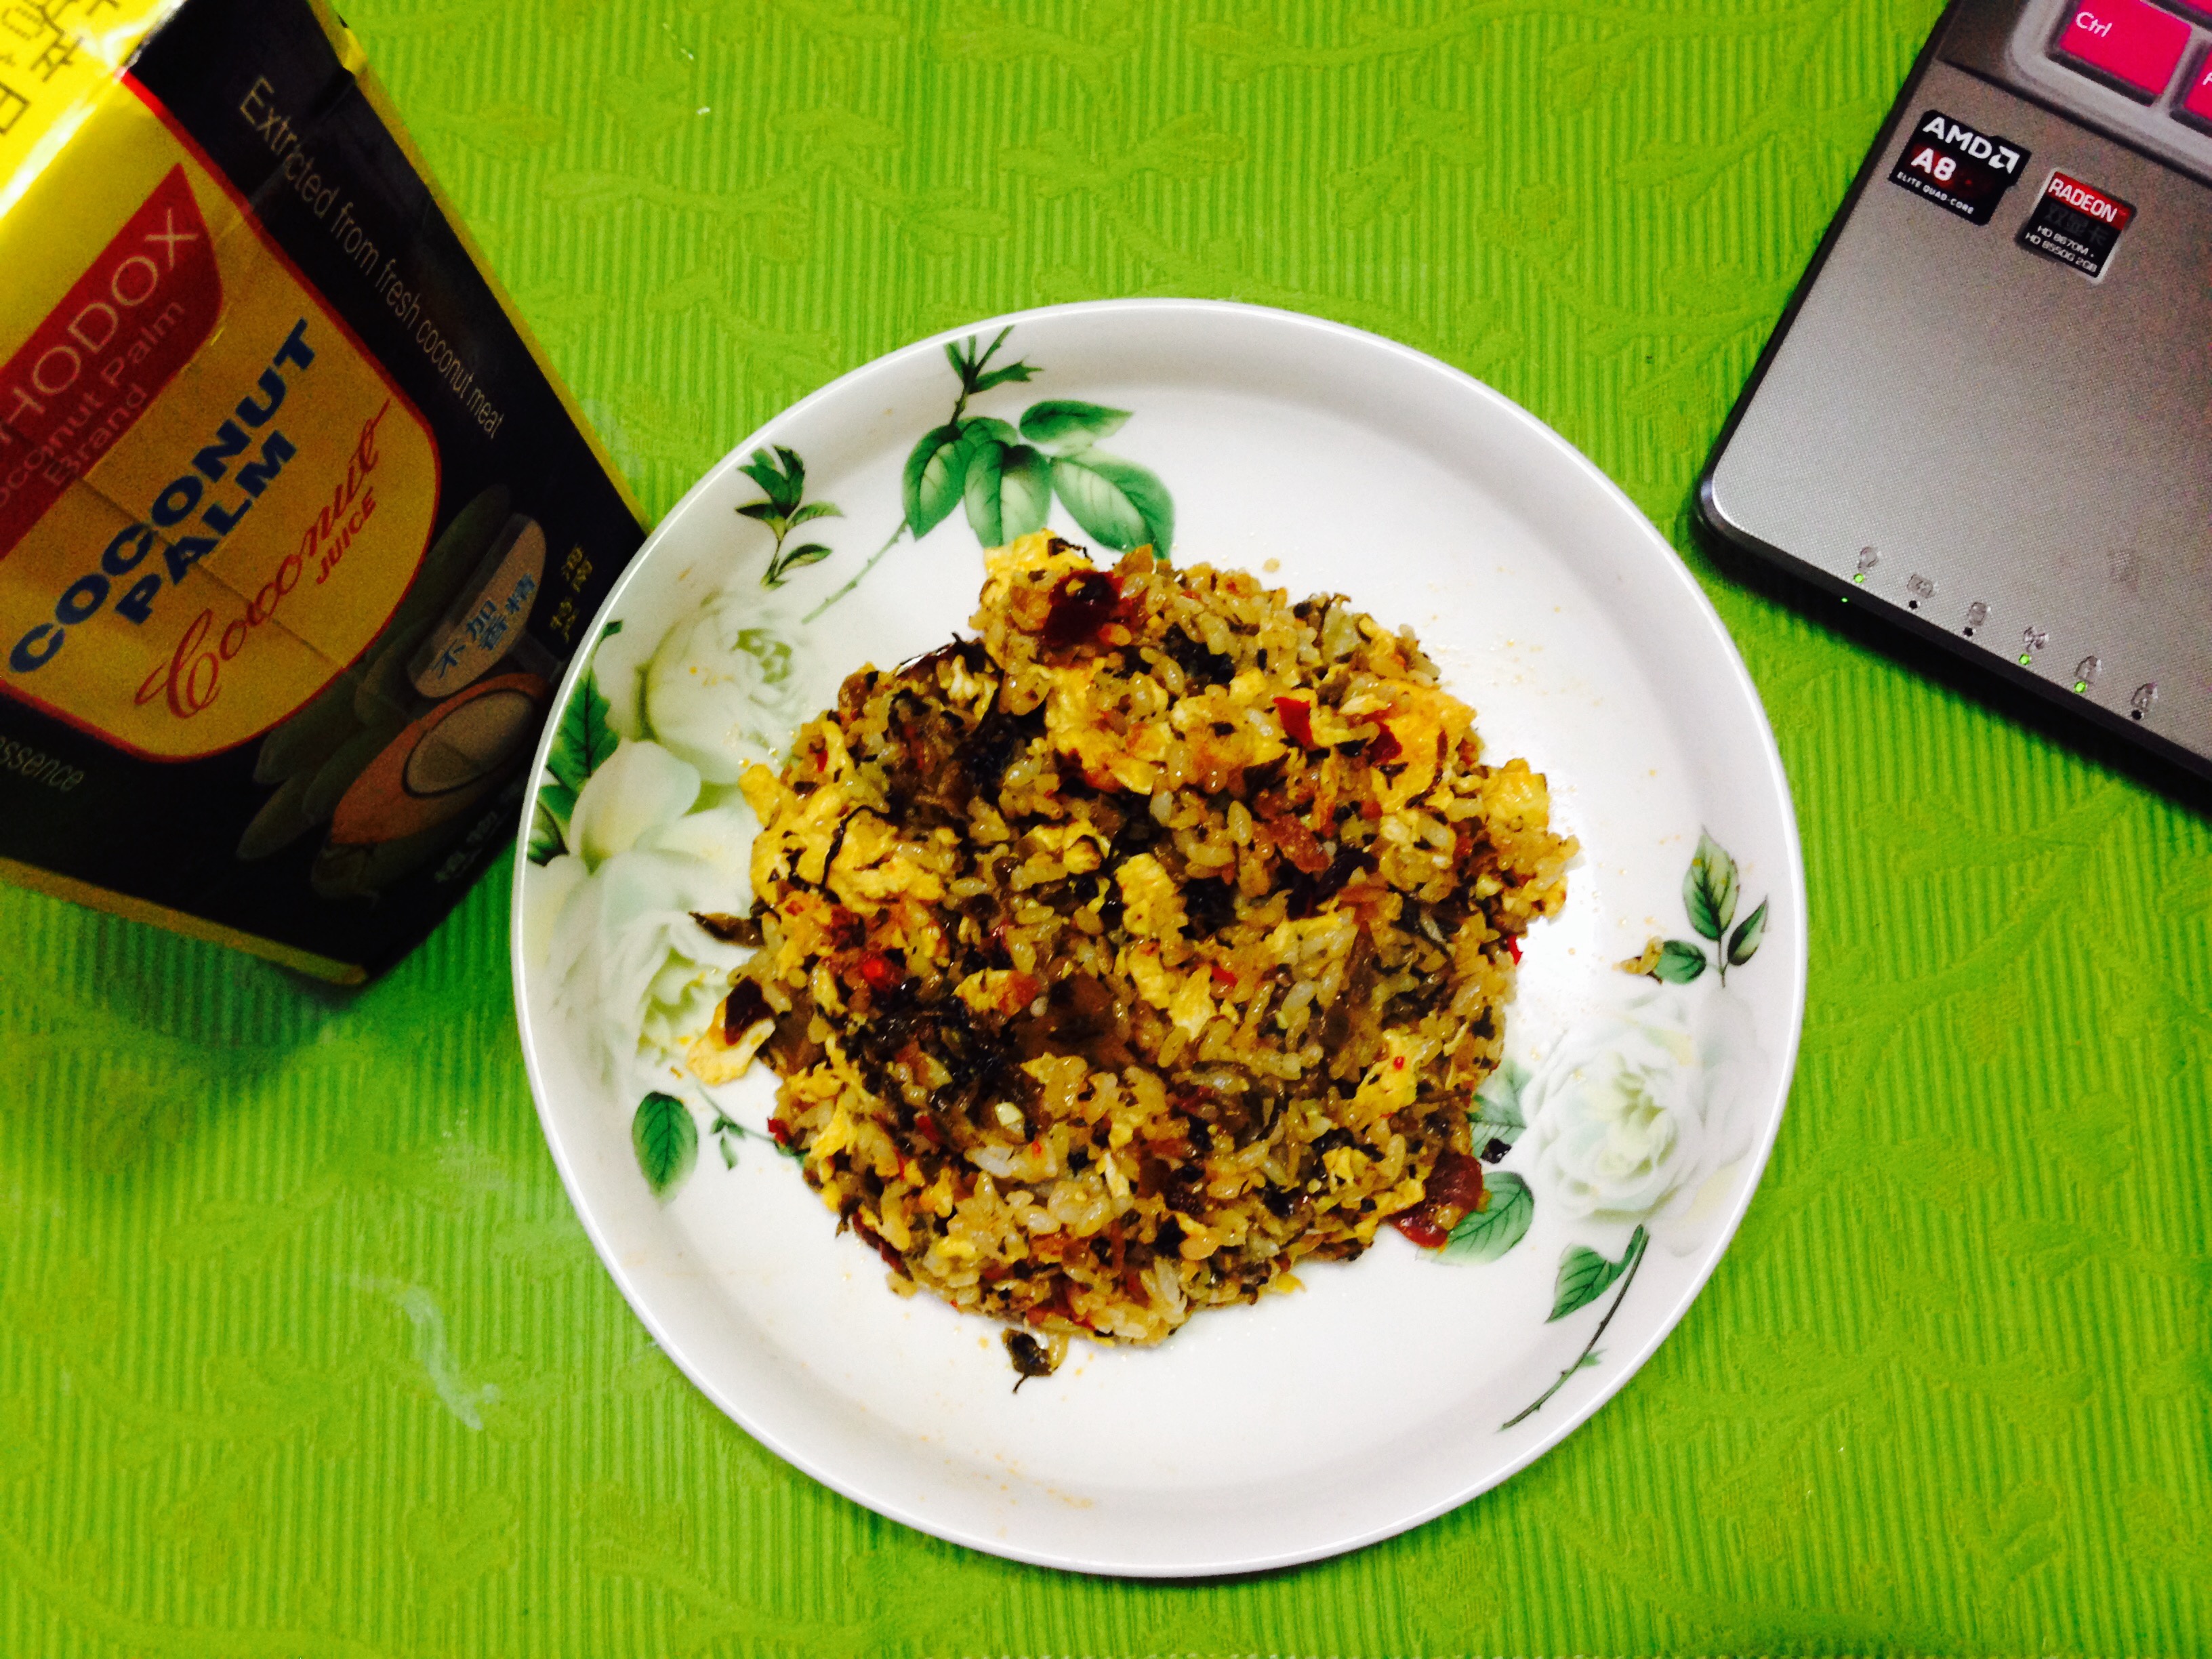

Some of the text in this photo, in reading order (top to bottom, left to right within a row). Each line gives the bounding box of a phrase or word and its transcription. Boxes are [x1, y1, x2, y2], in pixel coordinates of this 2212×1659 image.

[2075, 11, 2113, 38] Ctrl
[1896, 171, 1923, 188] ELITE
[1910, 148, 1957, 182] A8
[1922, 117, 1993, 159] AMD
[2048, 178, 2118, 222] RADEON
[100, 301, 187, 387] Palm
[330, 202, 380, 275] from
[375, 258, 422, 331] fresh
[414, 319, 476, 400] coconut
[466, 386, 506, 440] meat
[8, 316, 316, 674] COCONUT
[113, 430, 298, 626] PALM
[316, 486, 377, 585] JUICE
[134, 398, 391, 719] Coconut
